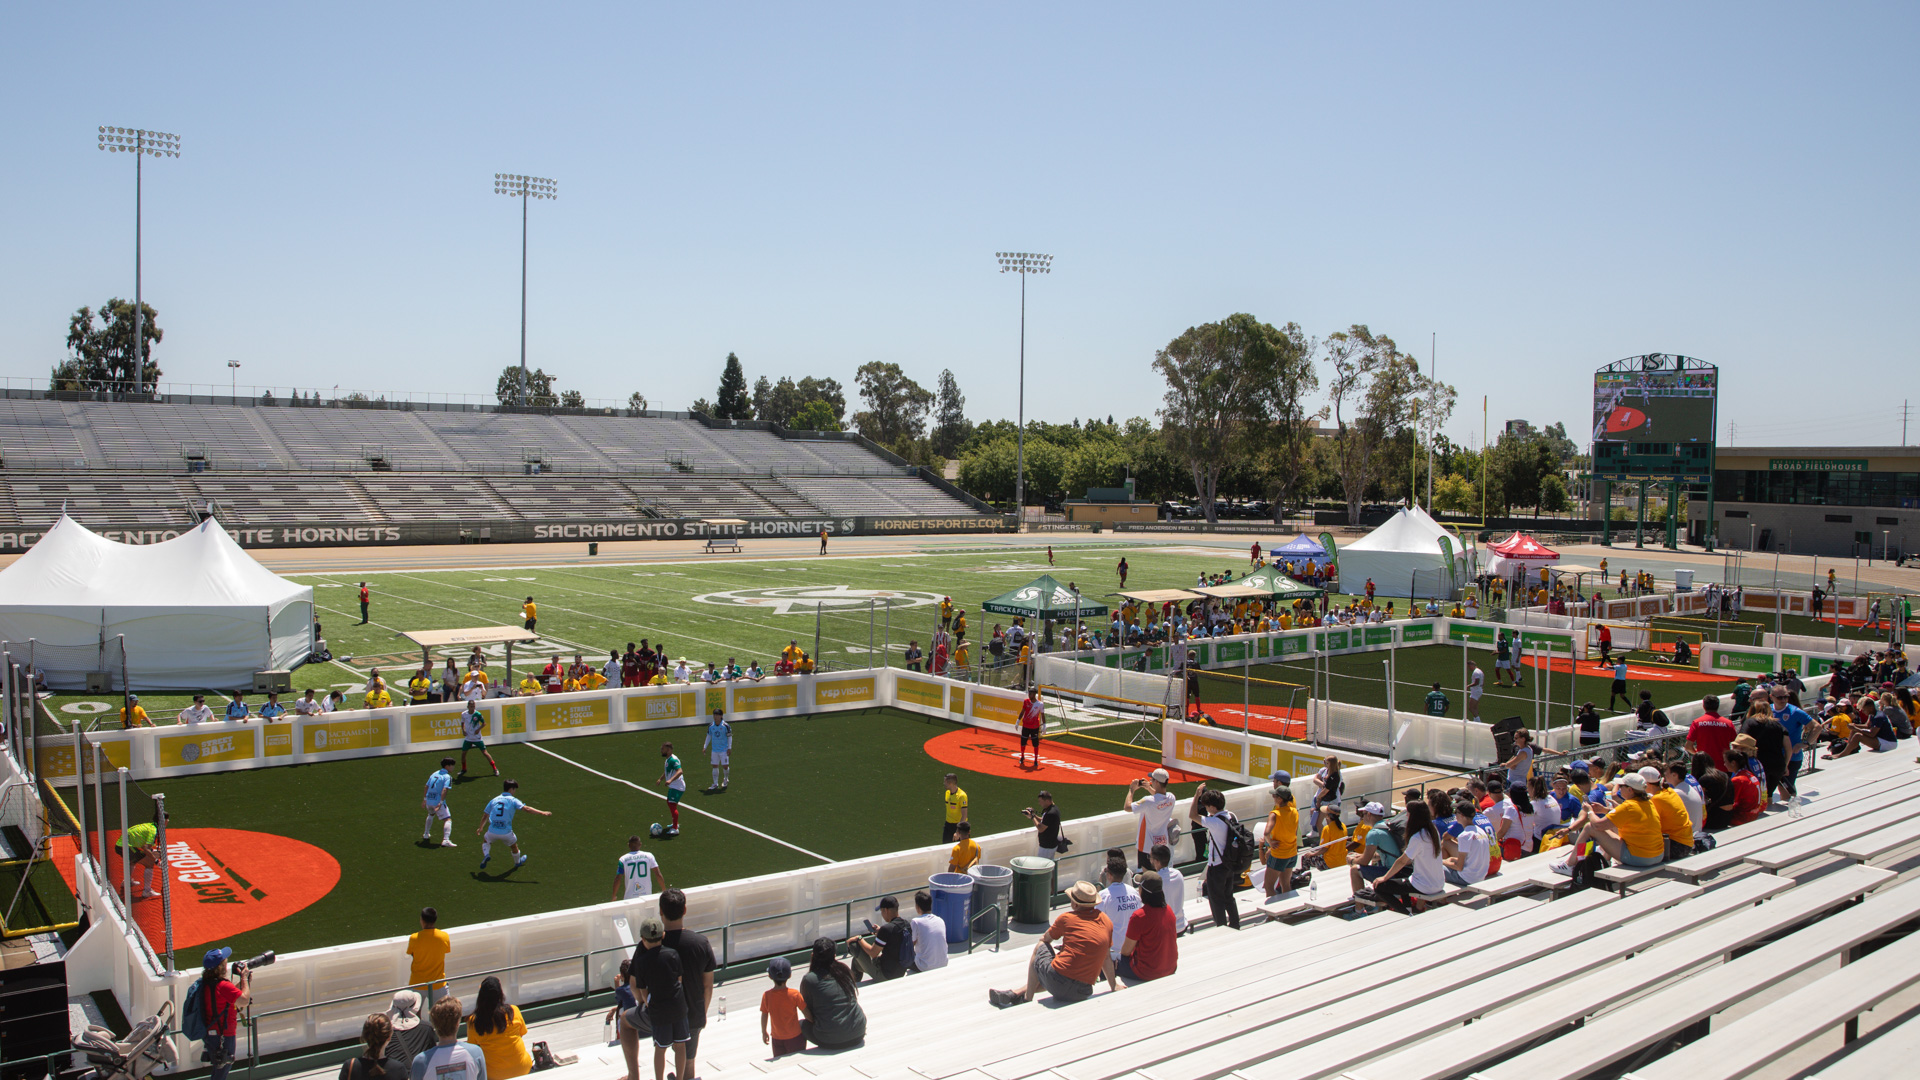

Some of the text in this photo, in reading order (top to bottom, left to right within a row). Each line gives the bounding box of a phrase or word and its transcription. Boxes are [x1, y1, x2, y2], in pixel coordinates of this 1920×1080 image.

[1805, 463, 1863, 471] FIELDHOUSE
[533, 520, 835, 539] SACRAMENTO STATE HORNETS
[874, 518, 1005, 530] HORNETSPORTS.COM
[1037, 523, 1091, 531] #STINGERSUP
[282, 526, 401, 544] HORNETS
[1283, 591, 1317, 599] #STINGERSUP
[1729, 656, 1766, 664] SACRAMENTO
[820, 688, 840, 698] vsp
[569, 705, 592, 713] STREET
[647, 700, 676, 715] DICK'S
[1433, 699, 1444, 711] 15
[569, 711, 594, 719] SOCCER
[1698, 720, 1728, 728] ROMÂNIA
[328, 727, 379, 738] SACRAMENTO
[434, 727, 462, 737] HEALT
[201, 735, 234, 748] STREET
[328, 737, 350, 746] STATE
[201, 741, 236, 758] BALL
[1193, 743, 1233, 758] SACRAMENTO
[1193, 751, 1210, 760] STATE
[430, 776, 439, 789] 7
[495, 801, 505, 817] 3
[166, 841, 221, 883] GLOBAL
[627, 860, 648, 880] 70
[188, 882, 245, 904] ACT
[1116, 894, 1137, 903] TEAM
[1117, 902, 1139, 912] ASHBY
